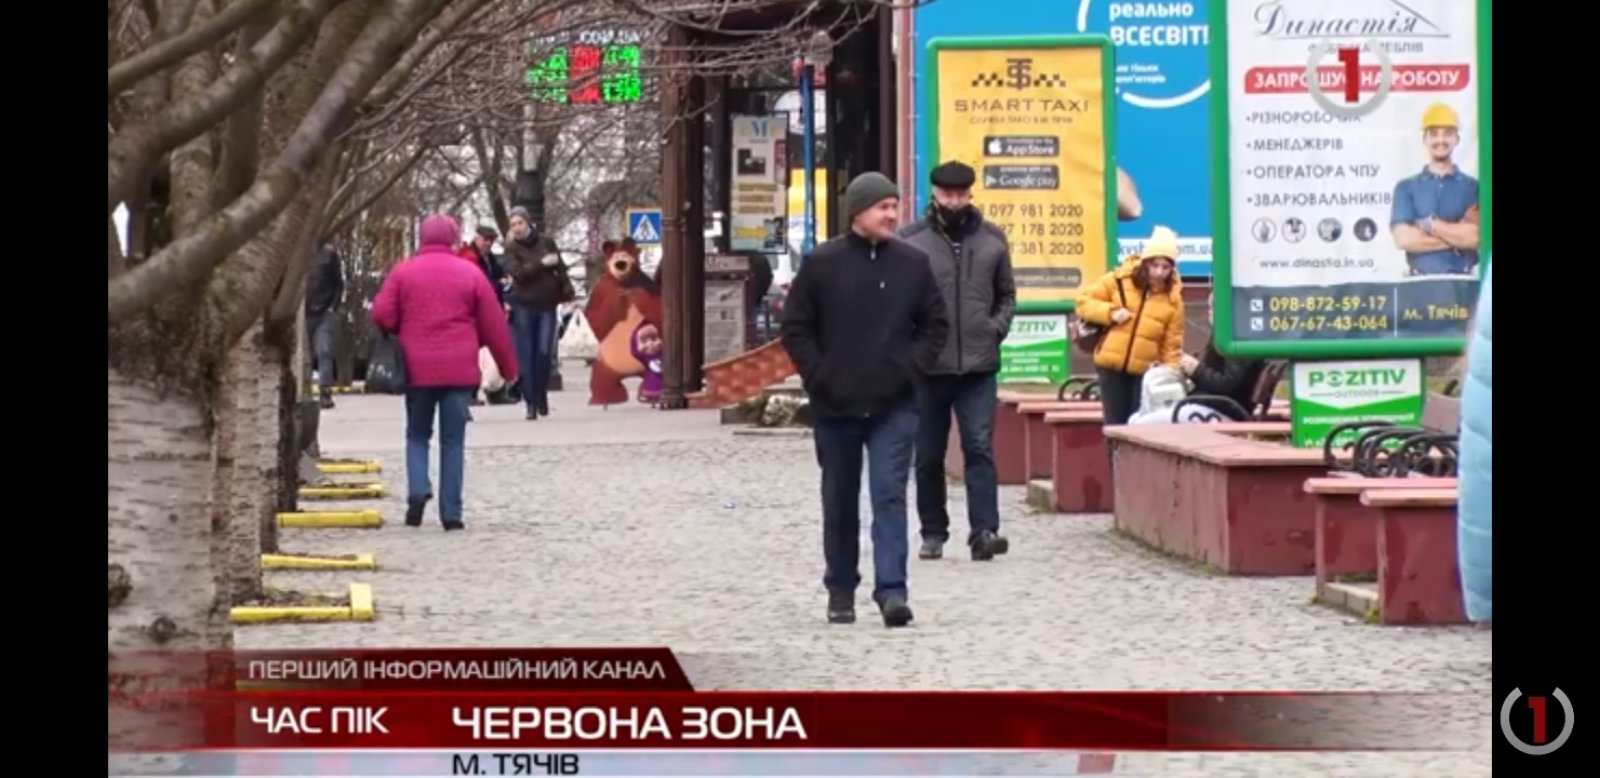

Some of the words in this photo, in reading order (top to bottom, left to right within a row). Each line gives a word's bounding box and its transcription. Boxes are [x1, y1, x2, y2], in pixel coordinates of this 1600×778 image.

[1109, 2, 1194, 22] реально
[1110, 25, 1209, 46] ВСЕСВІТ!
[1391, 70, 1460, 86] РОБОТУ
[955, 99, 1033, 112] SMART
[1040, 98, 1088, 111] TAXI
[1253, 139, 1344, 151] МЕНЕДЖЕРІВ
[1253, 165, 1346, 179] ОПЕРАТОРА
[1349, 165, 1380, 178] ЧПУ
[1000, 174, 1035, 190] Google
[1037, 175, 1057, 188] play
[1253, 192, 1391, 207] ЗВАРЮВАЛЬНИКІВ
[989, 204, 1015, 217] 097
[1020, 204, 1045, 217] 981
[1050, 204, 1084, 217] 2020
[1021, 224, 1045, 237] 178
[1050, 224, 1084, 237] 2020
[1020, 243, 1045, 255] 381
[1050, 242, 1084, 255] 2020
[1259, 257, 1374, 269] www.dinastia.in.ua
[1269, 295, 1387, 312] 098-872-59-17
[1403, 308, 1422, 320] м.
[1428, 304, 1468, 320] Тячів
[1269, 316, 1388, 332] 067-67-43-064
[1308, 369, 1406, 388] POZITIV
